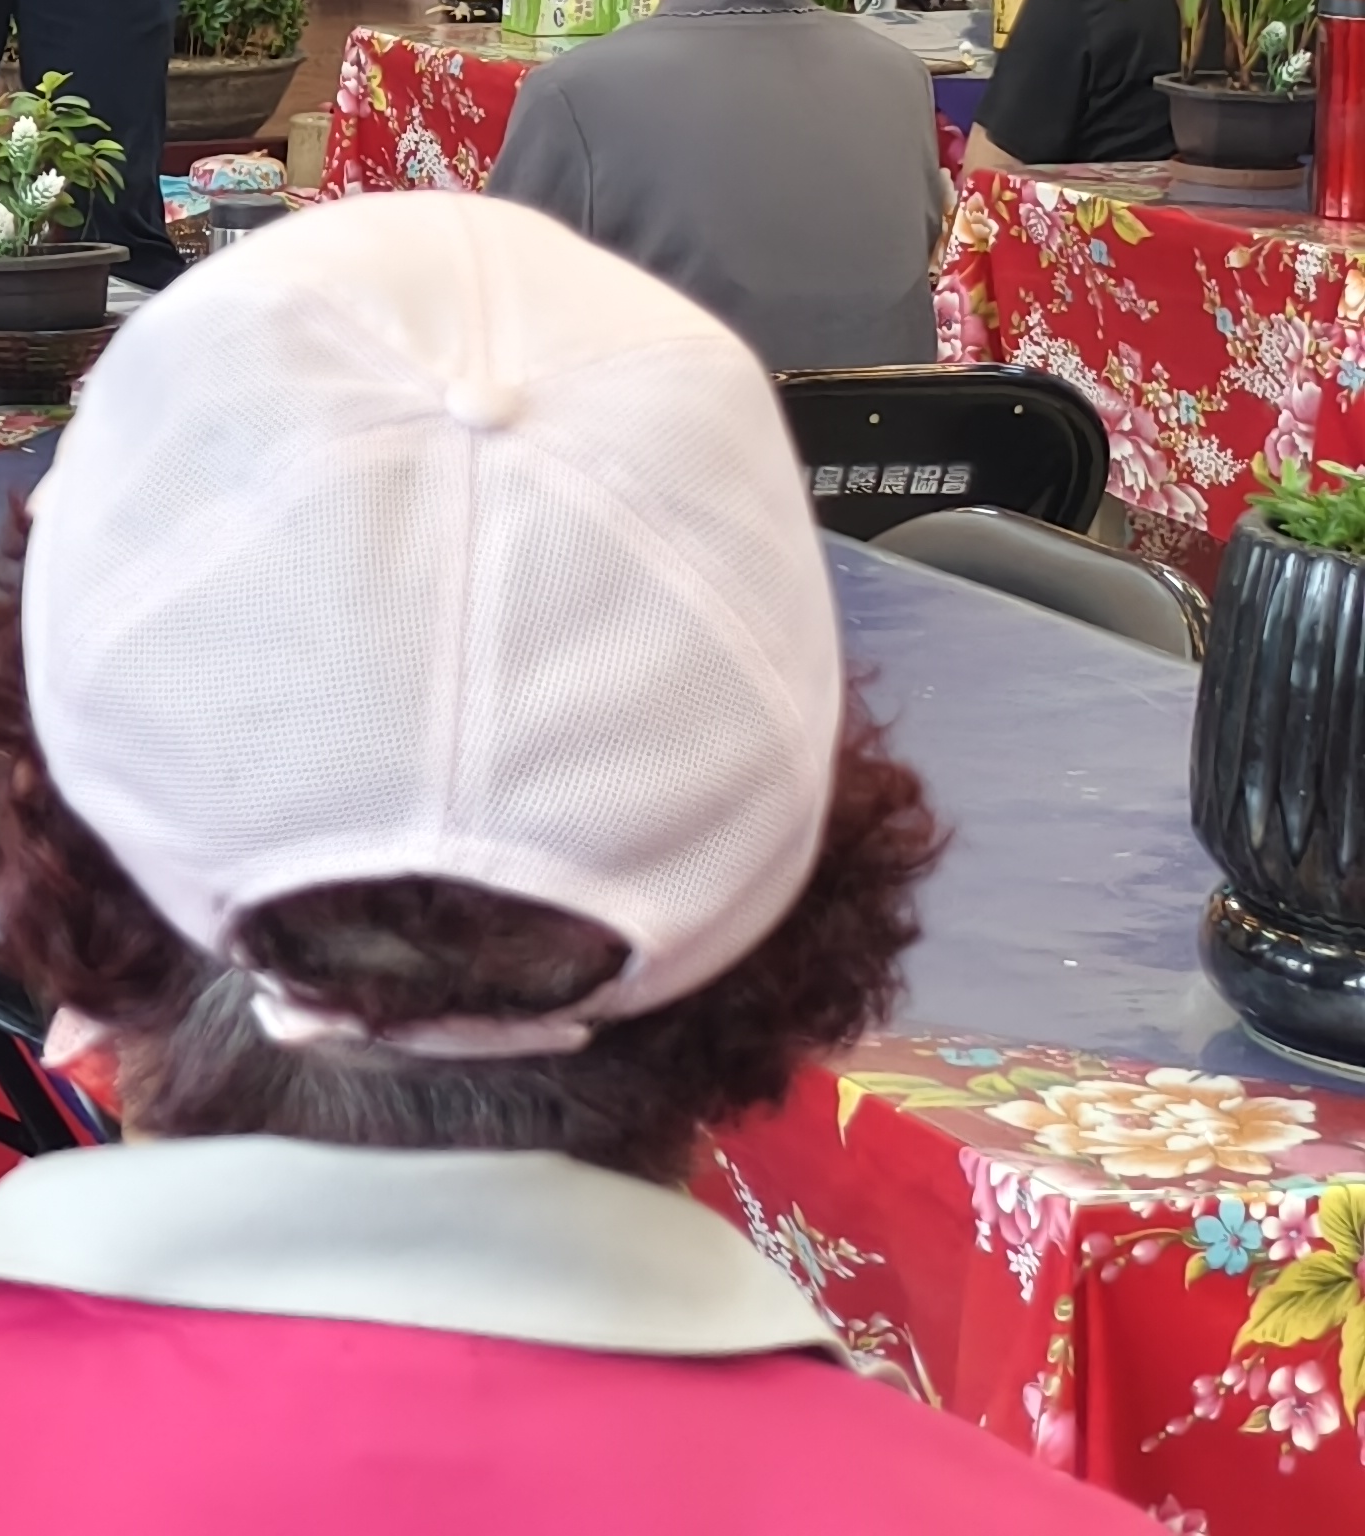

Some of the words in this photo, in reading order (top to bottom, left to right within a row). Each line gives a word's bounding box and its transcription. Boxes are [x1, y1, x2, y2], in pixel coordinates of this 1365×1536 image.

[803, 464, 970, 496] 里發展協會
